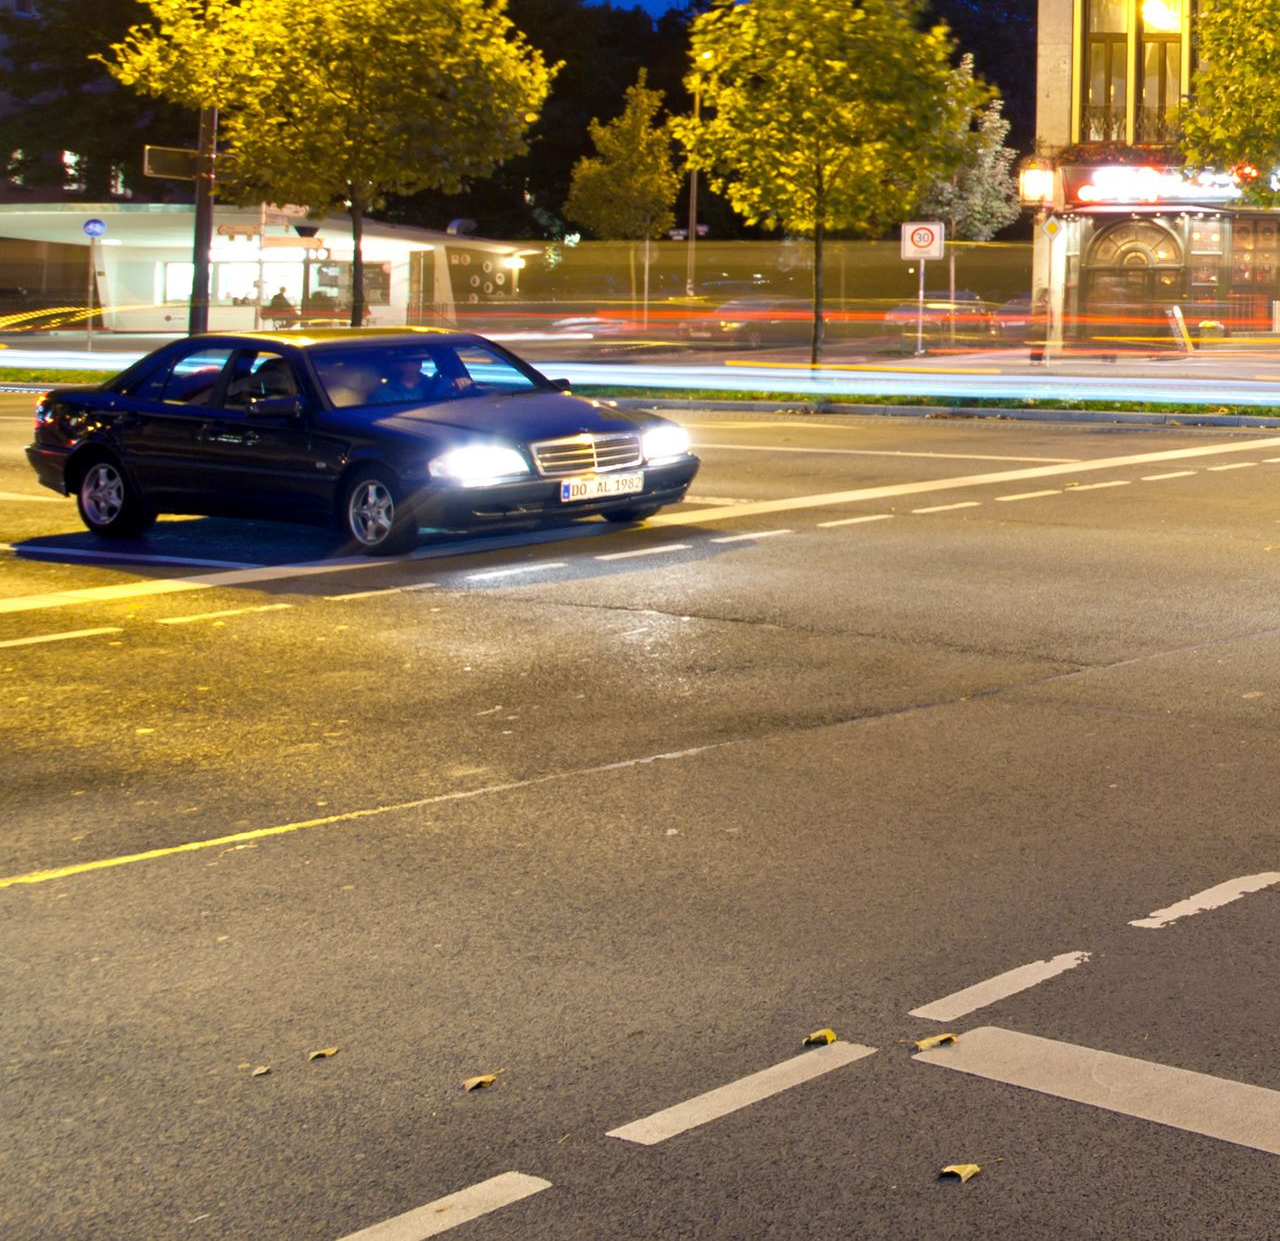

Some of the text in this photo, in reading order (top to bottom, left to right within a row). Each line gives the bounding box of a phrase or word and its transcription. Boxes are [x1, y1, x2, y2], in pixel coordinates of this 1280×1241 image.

[915, 233, 930, 243] 30
[571, 483, 587, 496] DO
[614, 476, 641, 492] 1982
